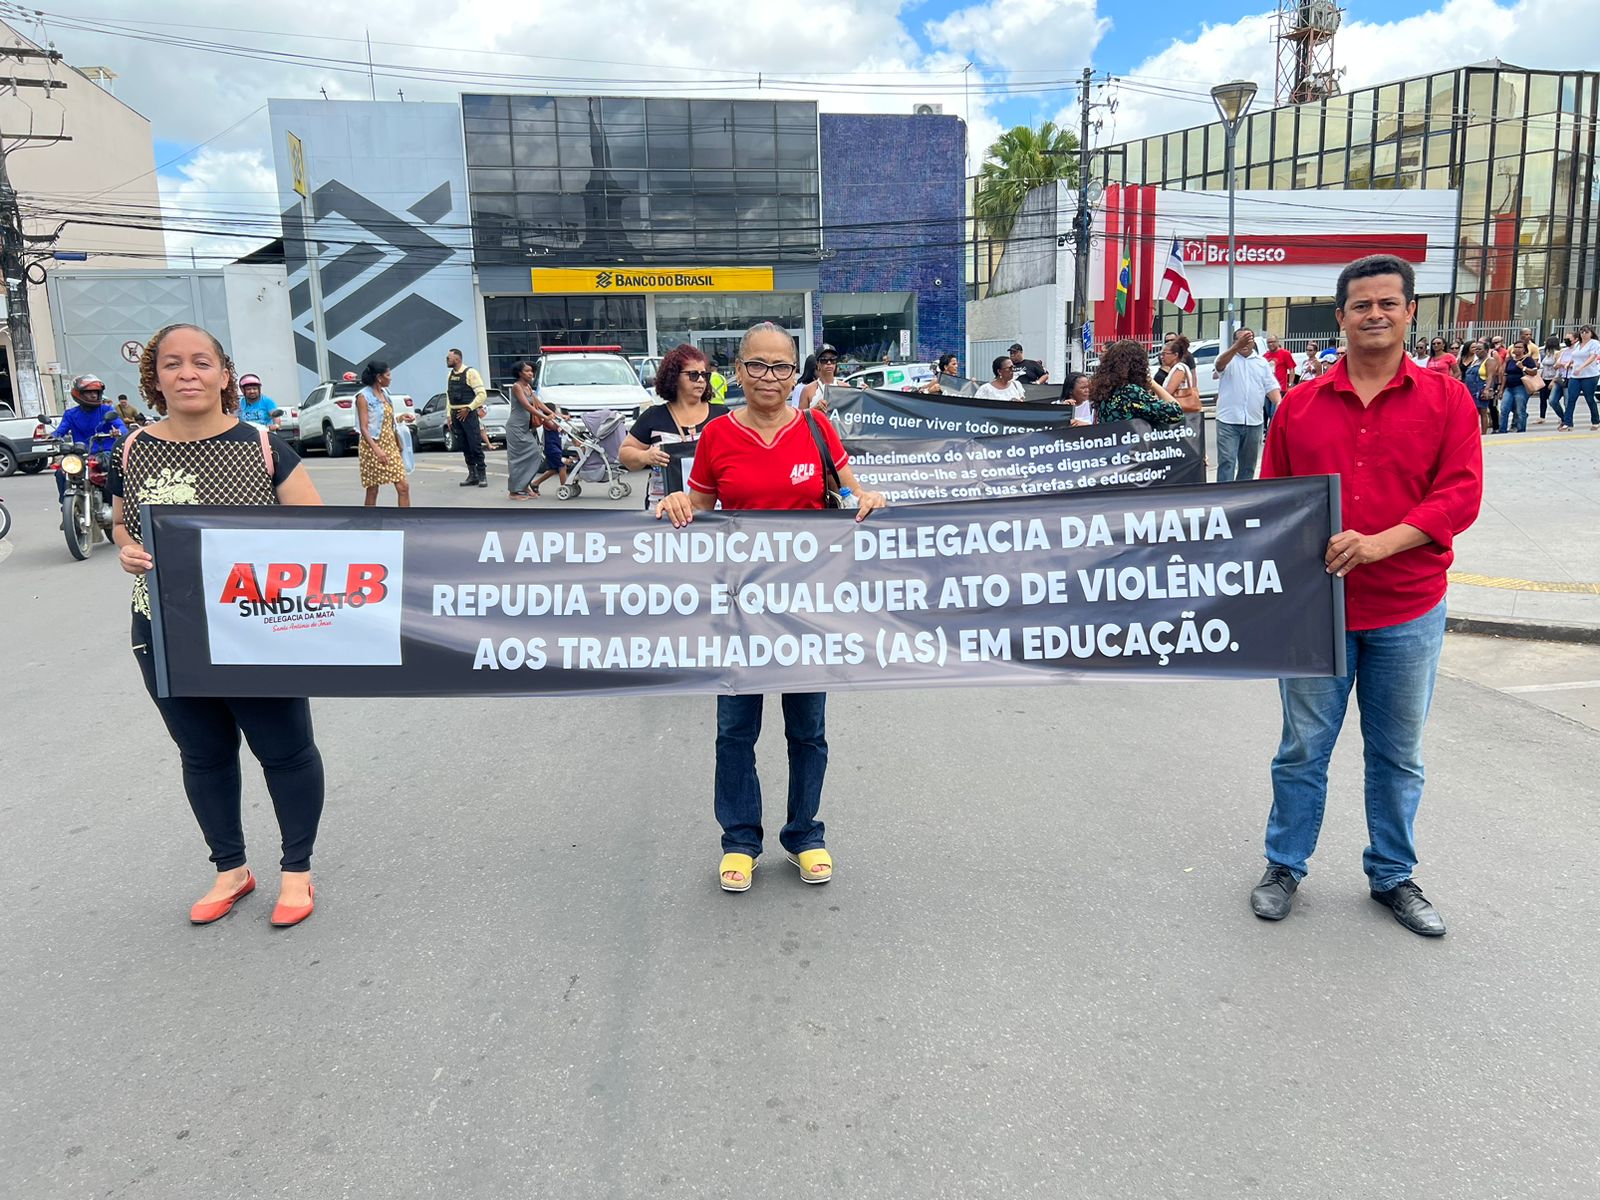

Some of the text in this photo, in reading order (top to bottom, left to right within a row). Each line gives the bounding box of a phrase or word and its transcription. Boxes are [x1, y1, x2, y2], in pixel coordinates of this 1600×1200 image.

[615, 274, 714, 286] BANCO DO BRASIL
[829, 408, 840, 421] A
[844, 412, 884, 425] gente
[889, 416, 922, 429] quer
[926, 418, 962, 431] viver
[965, 420, 998, 434] todo
[944, 450, 963, 462] do
[966, 448, 1002, 461] valor
[1006, 445, 1025, 458] do
[1029, 433, 1117, 458] profissional
[1121, 432, 1139, 445] da
[1143, 426, 1197, 442] educação,
[790, 463, 815, 478] APLB
[961, 469, 978, 479] as
[981, 462, 1054, 478] condições
[1057, 458, 1108, 472] dignas
[1111, 452, 1131, 465] de
[1135, 446, 1186, 462] trabalho,
[951, 486, 981, 497] com
[985, 485, 1018, 496] suas
[1021, 478, 1074, 494] tarefas
[1077, 475, 1096, 488] de
[1100, 465, 1171, 485] educador;"
[478, 531, 504, 563] A
[515, 532, 621, 563] APLB-
[632, 531, 818, 564] SINDICATO
[853, 518, 1051, 561] DELEGACIA
[1060, 514, 1114, 549] DA
[1124, 506, 1233, 546] MATA
[219, 562, 388, 604] APLB
[432, 555, 1283, 617] REPUDIA TODO E QUALQUER ATO DE VIOLÊNCIA
[239, 591, 367, 618] SINDICATO
[264, 611, 335, 624] DELEGACIA DA MATA
[473, 611, 1239, 670] AOS TRABALHADORES (AS) EM EDUCAÇÃO.
